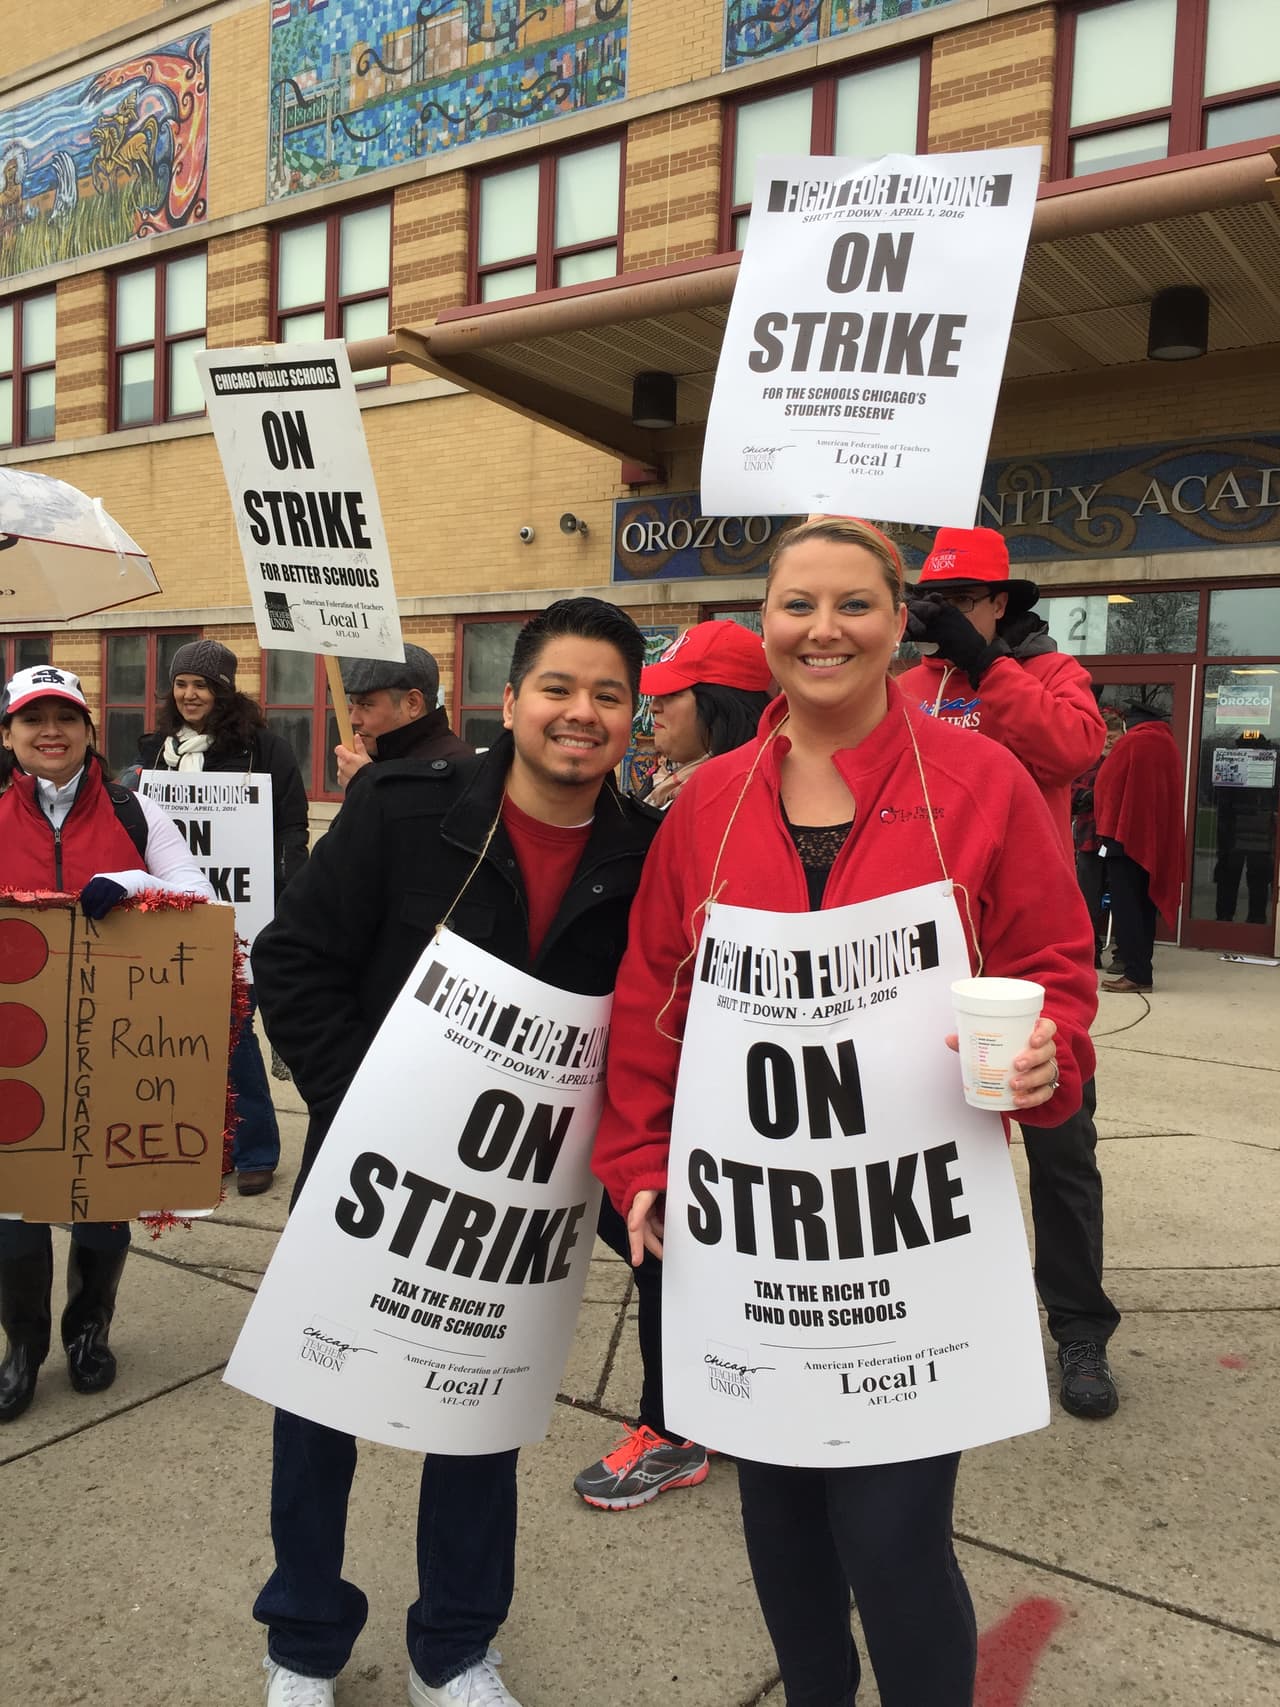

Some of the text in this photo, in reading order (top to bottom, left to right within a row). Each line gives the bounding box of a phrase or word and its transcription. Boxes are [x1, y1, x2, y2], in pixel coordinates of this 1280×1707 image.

[784, 174, 996, 212] FIGHT FOR FUNDING
[802, 208, 965, 224] SHUT IT DOWN APRIL 1, 2016
[826, 231, 915, 293] ON
[748, 311, 968, 378] STRIKE
[215, 366, 336, 390] CHICAGO PUBLIC SCHOOLS
[762, 387, 927, 405] FOR THE SCHOOLS CHICAGO'S
[784, 404, 895, 420] STUDENTS DESERVE
[261, 410, 315, 470] ON
[817, 439, 850, 447] American
[850, 441, 889, 450] Federation
[898, 444, 931, 452] Teachers
[744, 461, 774, 471] UNION
[835, 449, 903, 468] Local 1
[849, 468, 884, 476] AFL-CIO
[243, 489, 373, 550] STRIKE
[622, 515, 772, 553] OROZCO
[978, 483, 1103, 526] NITY
[260, 562, 380, 588] FOR BETTER SCHOOLS
[271, 619, 295, 630] UNION
[320, 609, 369, 629] Local 1
[1068, 606, 1087, 641] 2
[1219, 697, 1270, 706] OROZCO
[170, 784, 191, 803] FOR
[195, 785, 251, 804] FUNDING
[129, 942, 194, 1000] put
[708, 926, 921, 1000] FIGHT FOR FUNDING
[717, 986, 898, 1019] SHUT IT DOWN APRIL 1, 2016
[429, 973, 511, 1042] FIGHT
[506, 1010, 569, 1063] FOR
[112, 1016, 210, 1062] Rahm
[444, 1028, 485, 1054] SHUT
[484, 1047, 502, 1062] IT
[501, 1057, 549, 1080] DOWN
[556, 1073, 589, 1085] APRIL
[136, 1076, 175, 1105] on
[746, 1039, 867, 1141] ON
[105, 1122, 209, 1162] RED
[457, 1088, 576, 1184] ON
[687, 1141, 972, 1262] STRIKE
[334, 1151, 587, 1286] STRIKE
[391, 1277, 506, 1318] TAX THE RICH TO
[754, 1278, 891, 1302] TAX THE RICH TO
[370, 1293, 508, 1340] FUND OUR SCHOOLS
[744, 1301, 907, 1327] FUND OUR SCHOOLS
[302, 1326, 378, 1354] Chicago
[305, 1338, 348, 1361] TEACHERS
[301, 1346, 345, 1372] UNION
[403, 1353, 531, 1375] American Federation of Teachers
[704, 1354, 776, 1376] Chicago
[803, 1340, 969, 1370] American Federation of Teachers
[424, 1371, 505, 1396] Local 1
[709, 1366, 751, 1386] TEACHERS
[710, 1377, 752, 1400] UNION
[839, 1360, 939, 1395] Local 1
[440, 1396, 480, 1407] AFL-CIO
[868, 1391, 918, 1407] AFL-CIO
